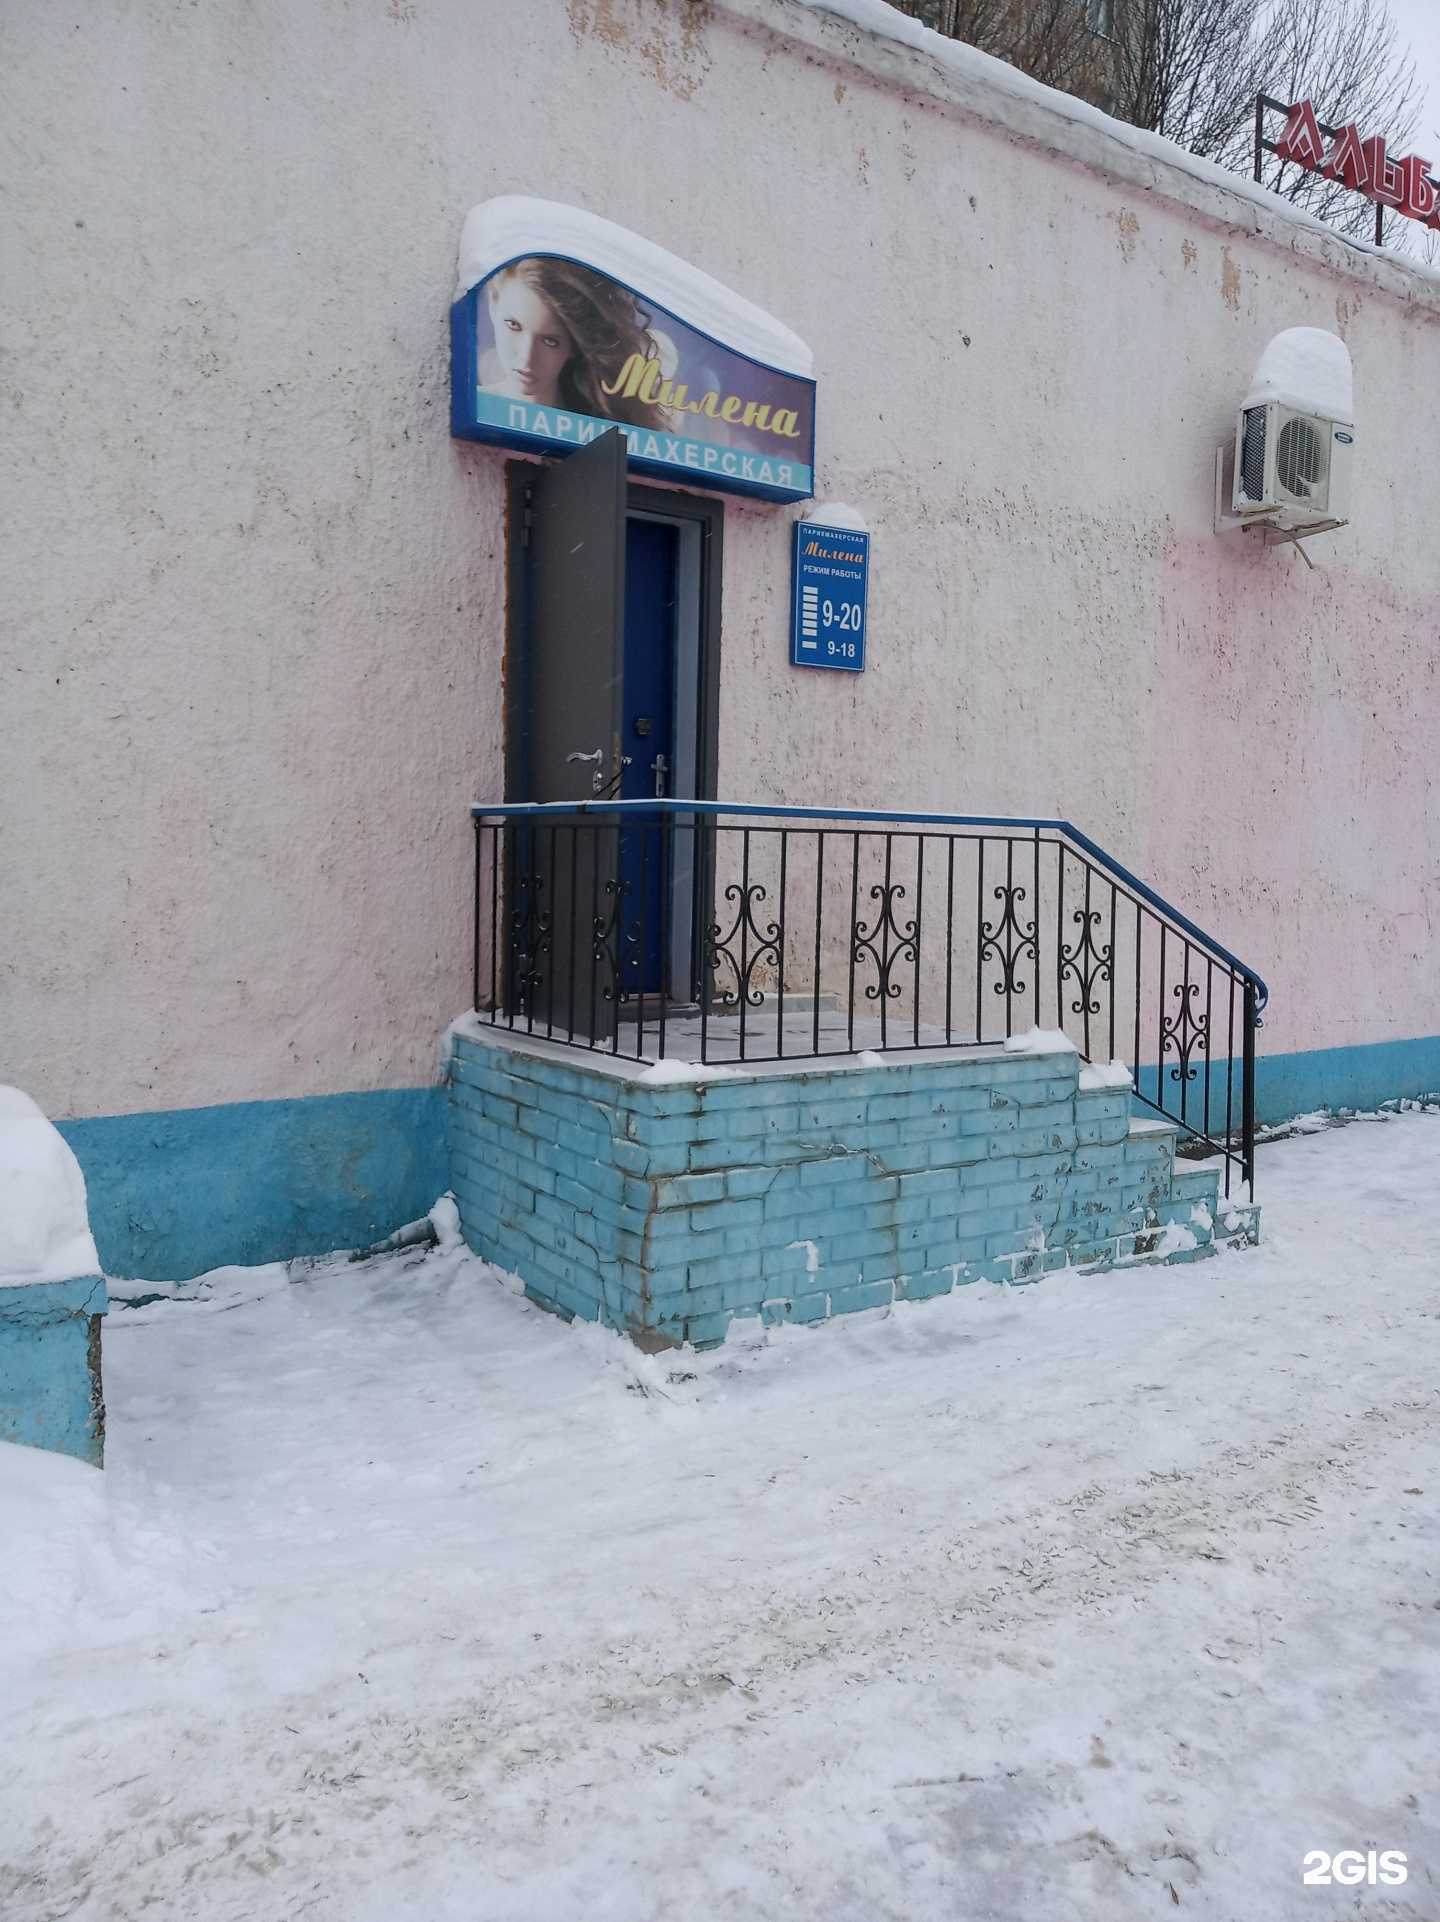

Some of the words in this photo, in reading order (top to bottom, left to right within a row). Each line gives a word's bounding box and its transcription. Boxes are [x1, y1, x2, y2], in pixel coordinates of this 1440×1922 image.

[1277, 98, 1440, 232] АЛЬБ
[601, 352, 800, 438] Милена
[508, 404, 793, 487] ПАРИМАХЕРСКАЯ
[803, 528, 864, 543] ПАРИКМАХЕРСКАЯ
[801, 541, 864, 563] Милена
[803, 564, 830, 576] РЕЖИМ
[831, 568, 862, 580] РАБОТЫ
[822, 599, 862, 632] 9-20
[827, 640, 856, 658] 9-18
